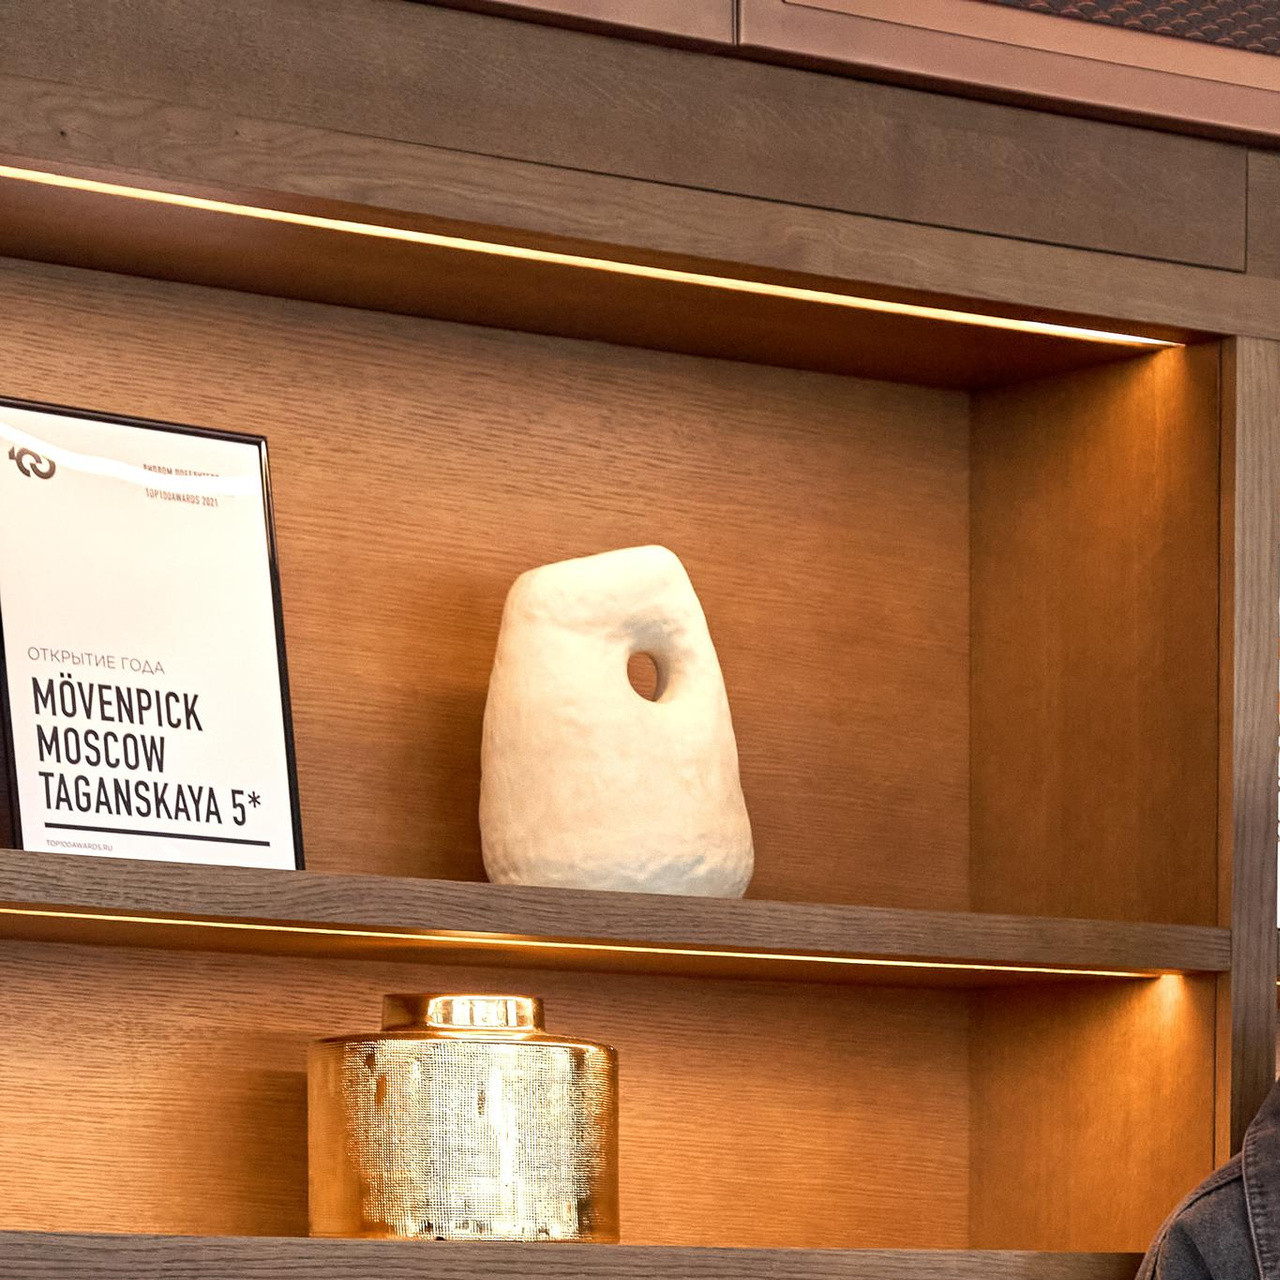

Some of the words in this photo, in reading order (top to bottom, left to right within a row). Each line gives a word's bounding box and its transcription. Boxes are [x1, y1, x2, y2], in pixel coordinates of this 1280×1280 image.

[202, 495, 219, 508] 2021
[27, 646, 116, 669] ОТКРЫТИЕ
[121, 657, 166, 675] ГОДА
[31, 672, 203, 732] MÖVENPICK
[36, 724, 165, 773] MOSCOW
[38, 771, 223, 824] TAGANSKAYA
